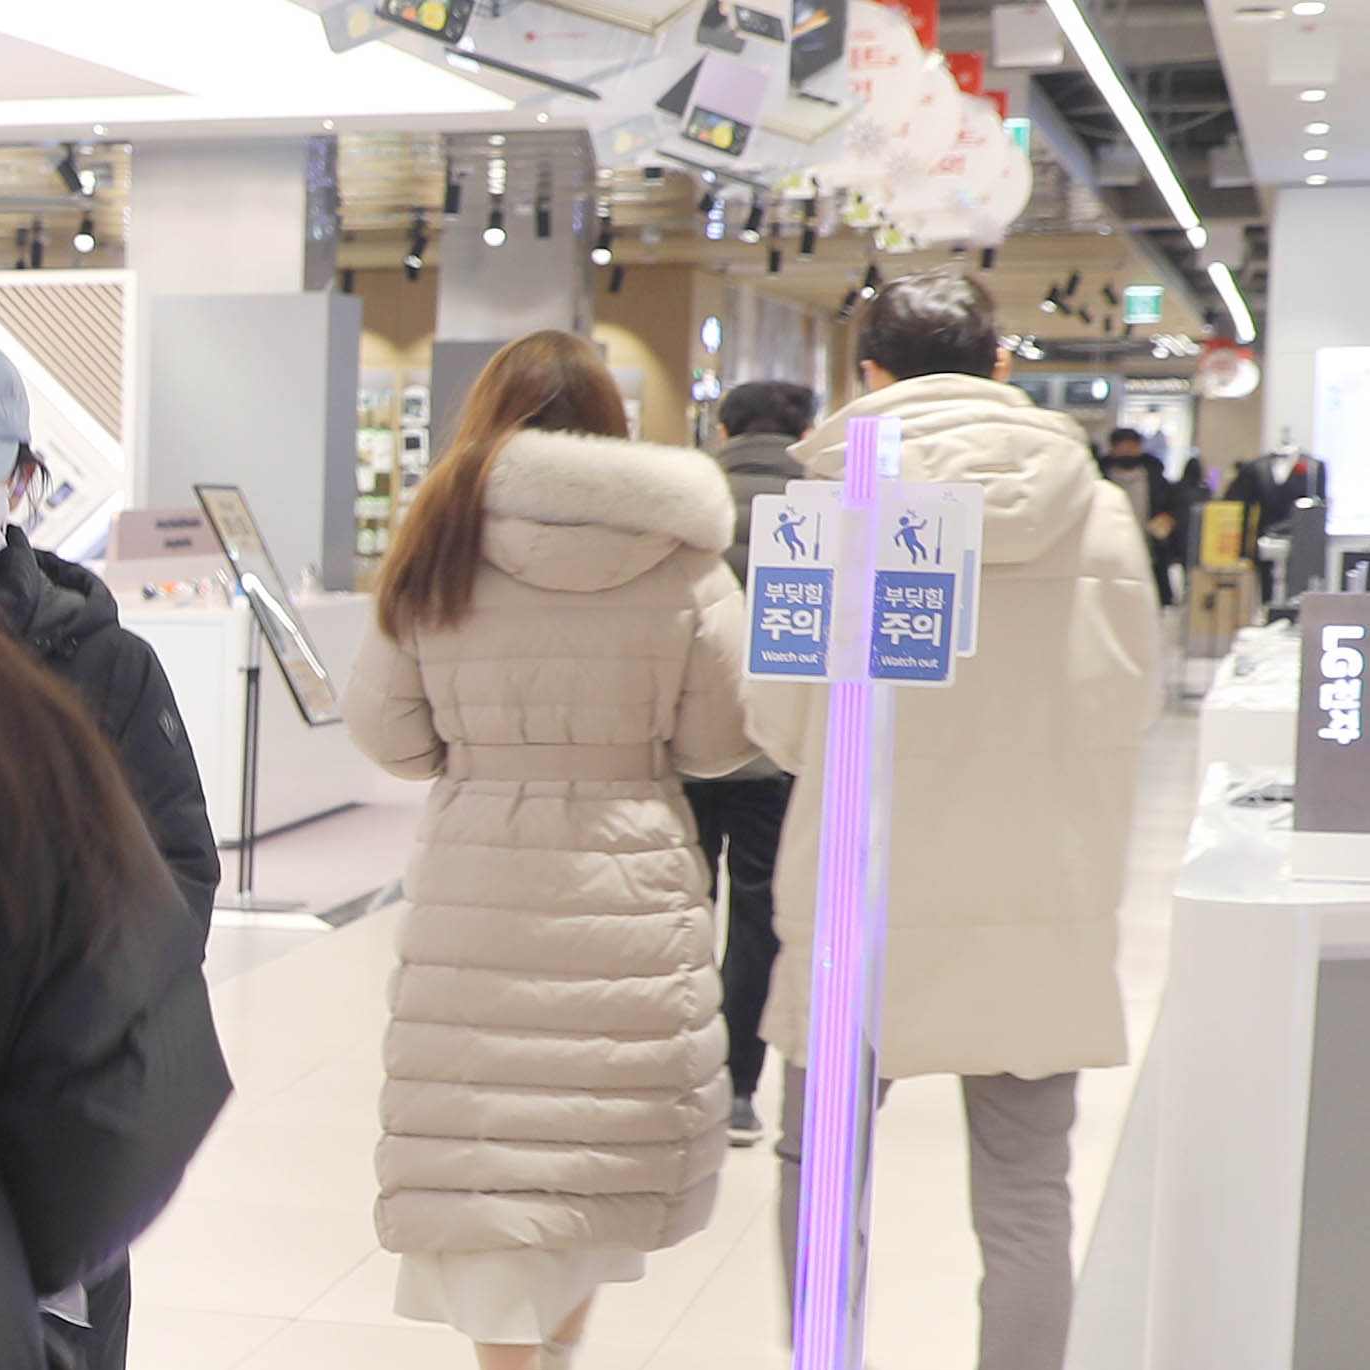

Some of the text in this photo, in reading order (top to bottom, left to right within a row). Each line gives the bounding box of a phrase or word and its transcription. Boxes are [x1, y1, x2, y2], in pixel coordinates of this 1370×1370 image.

[764, 582, 823, 606] 부딪힘
[883, 586, 945, 610] 부딪힘
[760, 608, 823, 643] 주의
[880, 613, 942, 648] 주의
[761, 650, 820, 665] Watch out
[880, 655, 939, 670] Watch out
